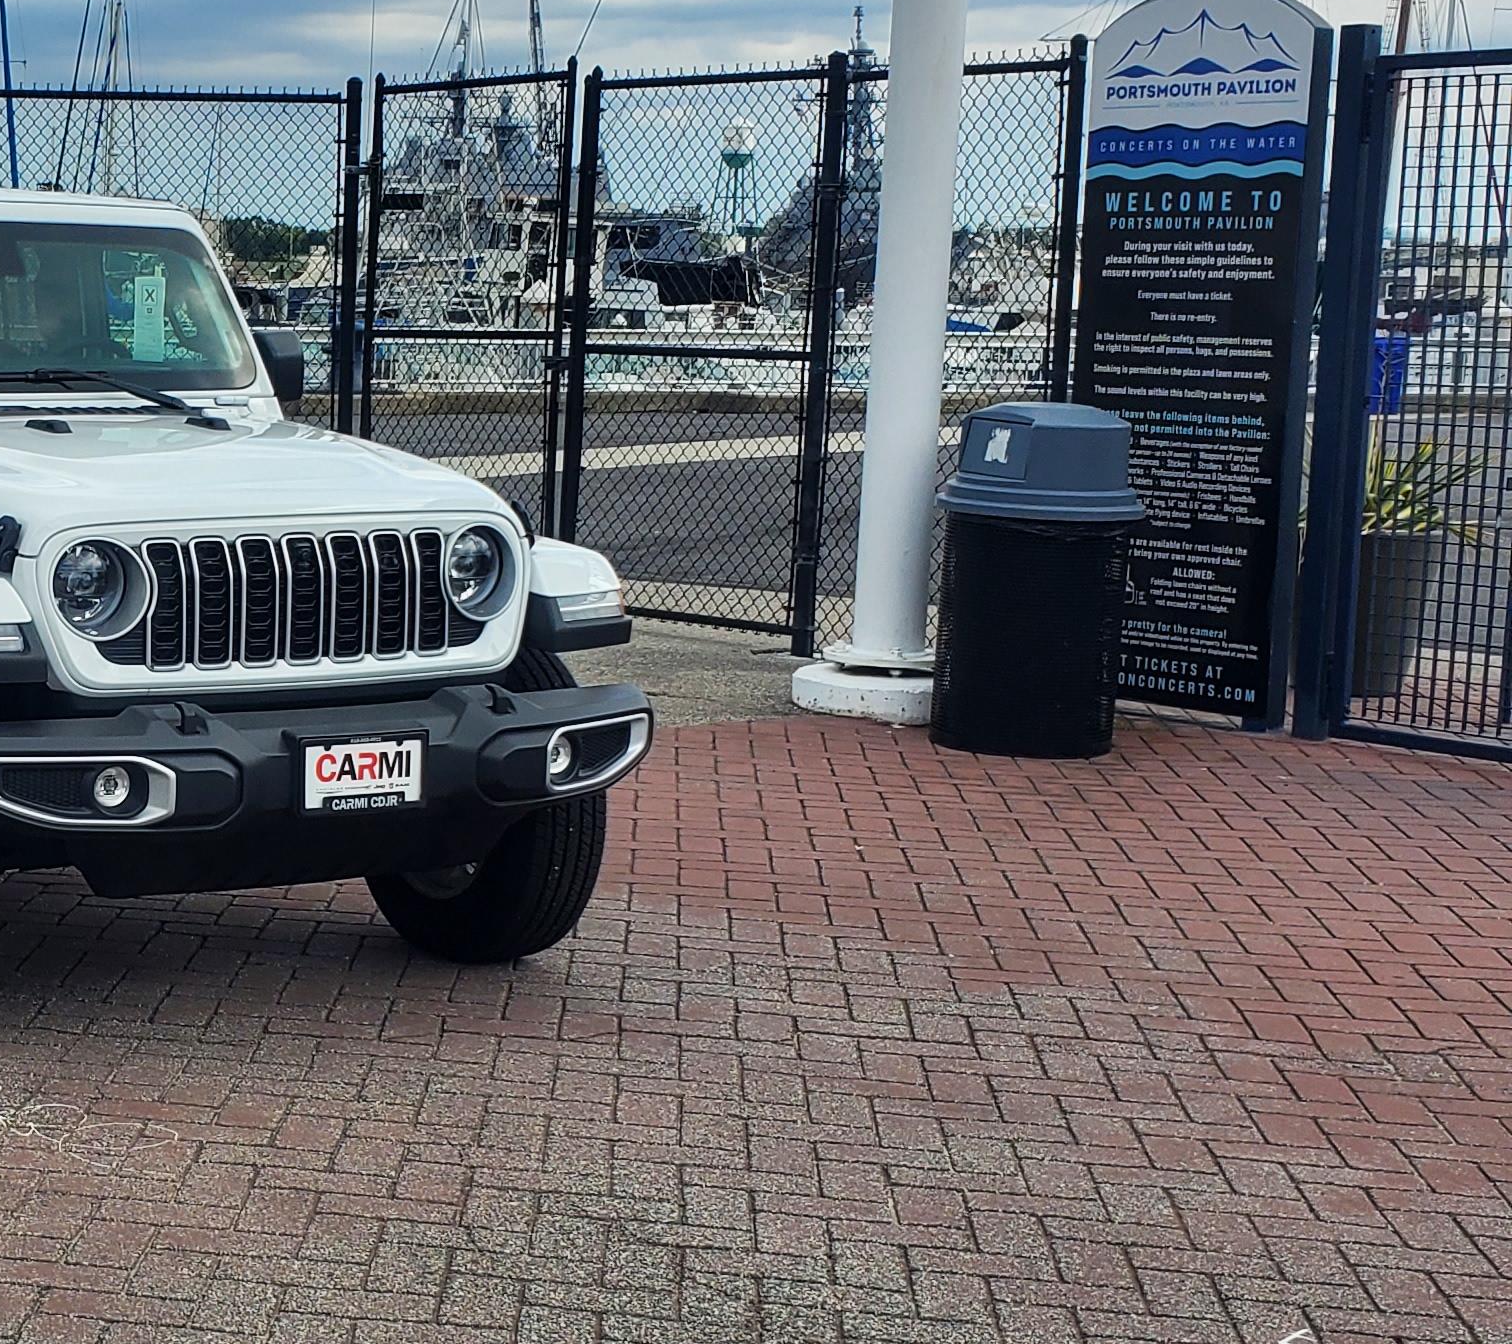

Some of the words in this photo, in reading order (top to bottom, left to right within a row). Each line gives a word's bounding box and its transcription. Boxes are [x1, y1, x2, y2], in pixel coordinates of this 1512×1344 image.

[1106, 82, 1212, 100] PORTSMOUTH
[1217, 78, 1297, 96] PAVILION
[1100, 140, 1173, 153] CONCERTS
[1183, 139, 1200, 150] ON
[1210, 138, 1237, 149] THE
[1247, 137, 1296, 148] WATER
[1105, 191, 1233, 213] WELCOME
[1251, 190, 1282, 212] TO
[1109, 217, 1201, 230] PORTSMOUTH
[1207, 216, 1274, 229] PAVILION
[1124, 241, 1150, 253] During
[1152, 242, 1172, 253] your
[1174, 241, 1192, 251] visit
[1194, 241, 1213, 251] with
[1215, 242, 1225, 252] us
[1105, 255, 1131, 266] please
[1134, 255, 1159, 265] follow
[1161, 255, 1185, 265] these
[1187, 256, 1215, 266] simple
[1217, 256, 1262, 267] guidelines
[1264, 256, 1273, 266] to
[1102, 269, 1130, 277] ensure
[1132, 268, 1177, 279] everyone's
[1178, 269, 1206, 280] safety
[1208, 269, 1224, 279] and
[1226, 269, 1275, 281] enjoyment.
[1137, 290, 1168, 301] Everyone
[1169, 291, 1186, 300] must
[1187, 291, 1204, 301] have
[1150, 311, 1169, 321] There
[1122, 408, 1145, 419] leave
[1147, 411, 1161, 420] the
[1163, 411, 1203, 424] following
[1205, 412, 1230, 424] items
[1134, 424, 1149, 433] not
[1150, 424, 1193, 435] permitted
[1195, 426, 1213, 436] into
[1215, 427, 1230, 437] the
[1128, 458, 1159, 466] ubstances
[1182, 541, 1193, 550] for
[1172, 567, 1216, 581] ALLOWED:
[1128, 619, 1155, 632] pretty
[1157, 621, 1171, 632] for
[1173, 623, 1188, 635] the
[1135, 655, 1198, 676] TICKETS
[1205, 665, 1224, 680] AT
[1118, 672, 1255, 703] ONCONCERTS.COM
[315, 750, 412, 783] CARMI
[332, 797, 368, 811] CARMI
[370, 795, 398, 807] CDJR
